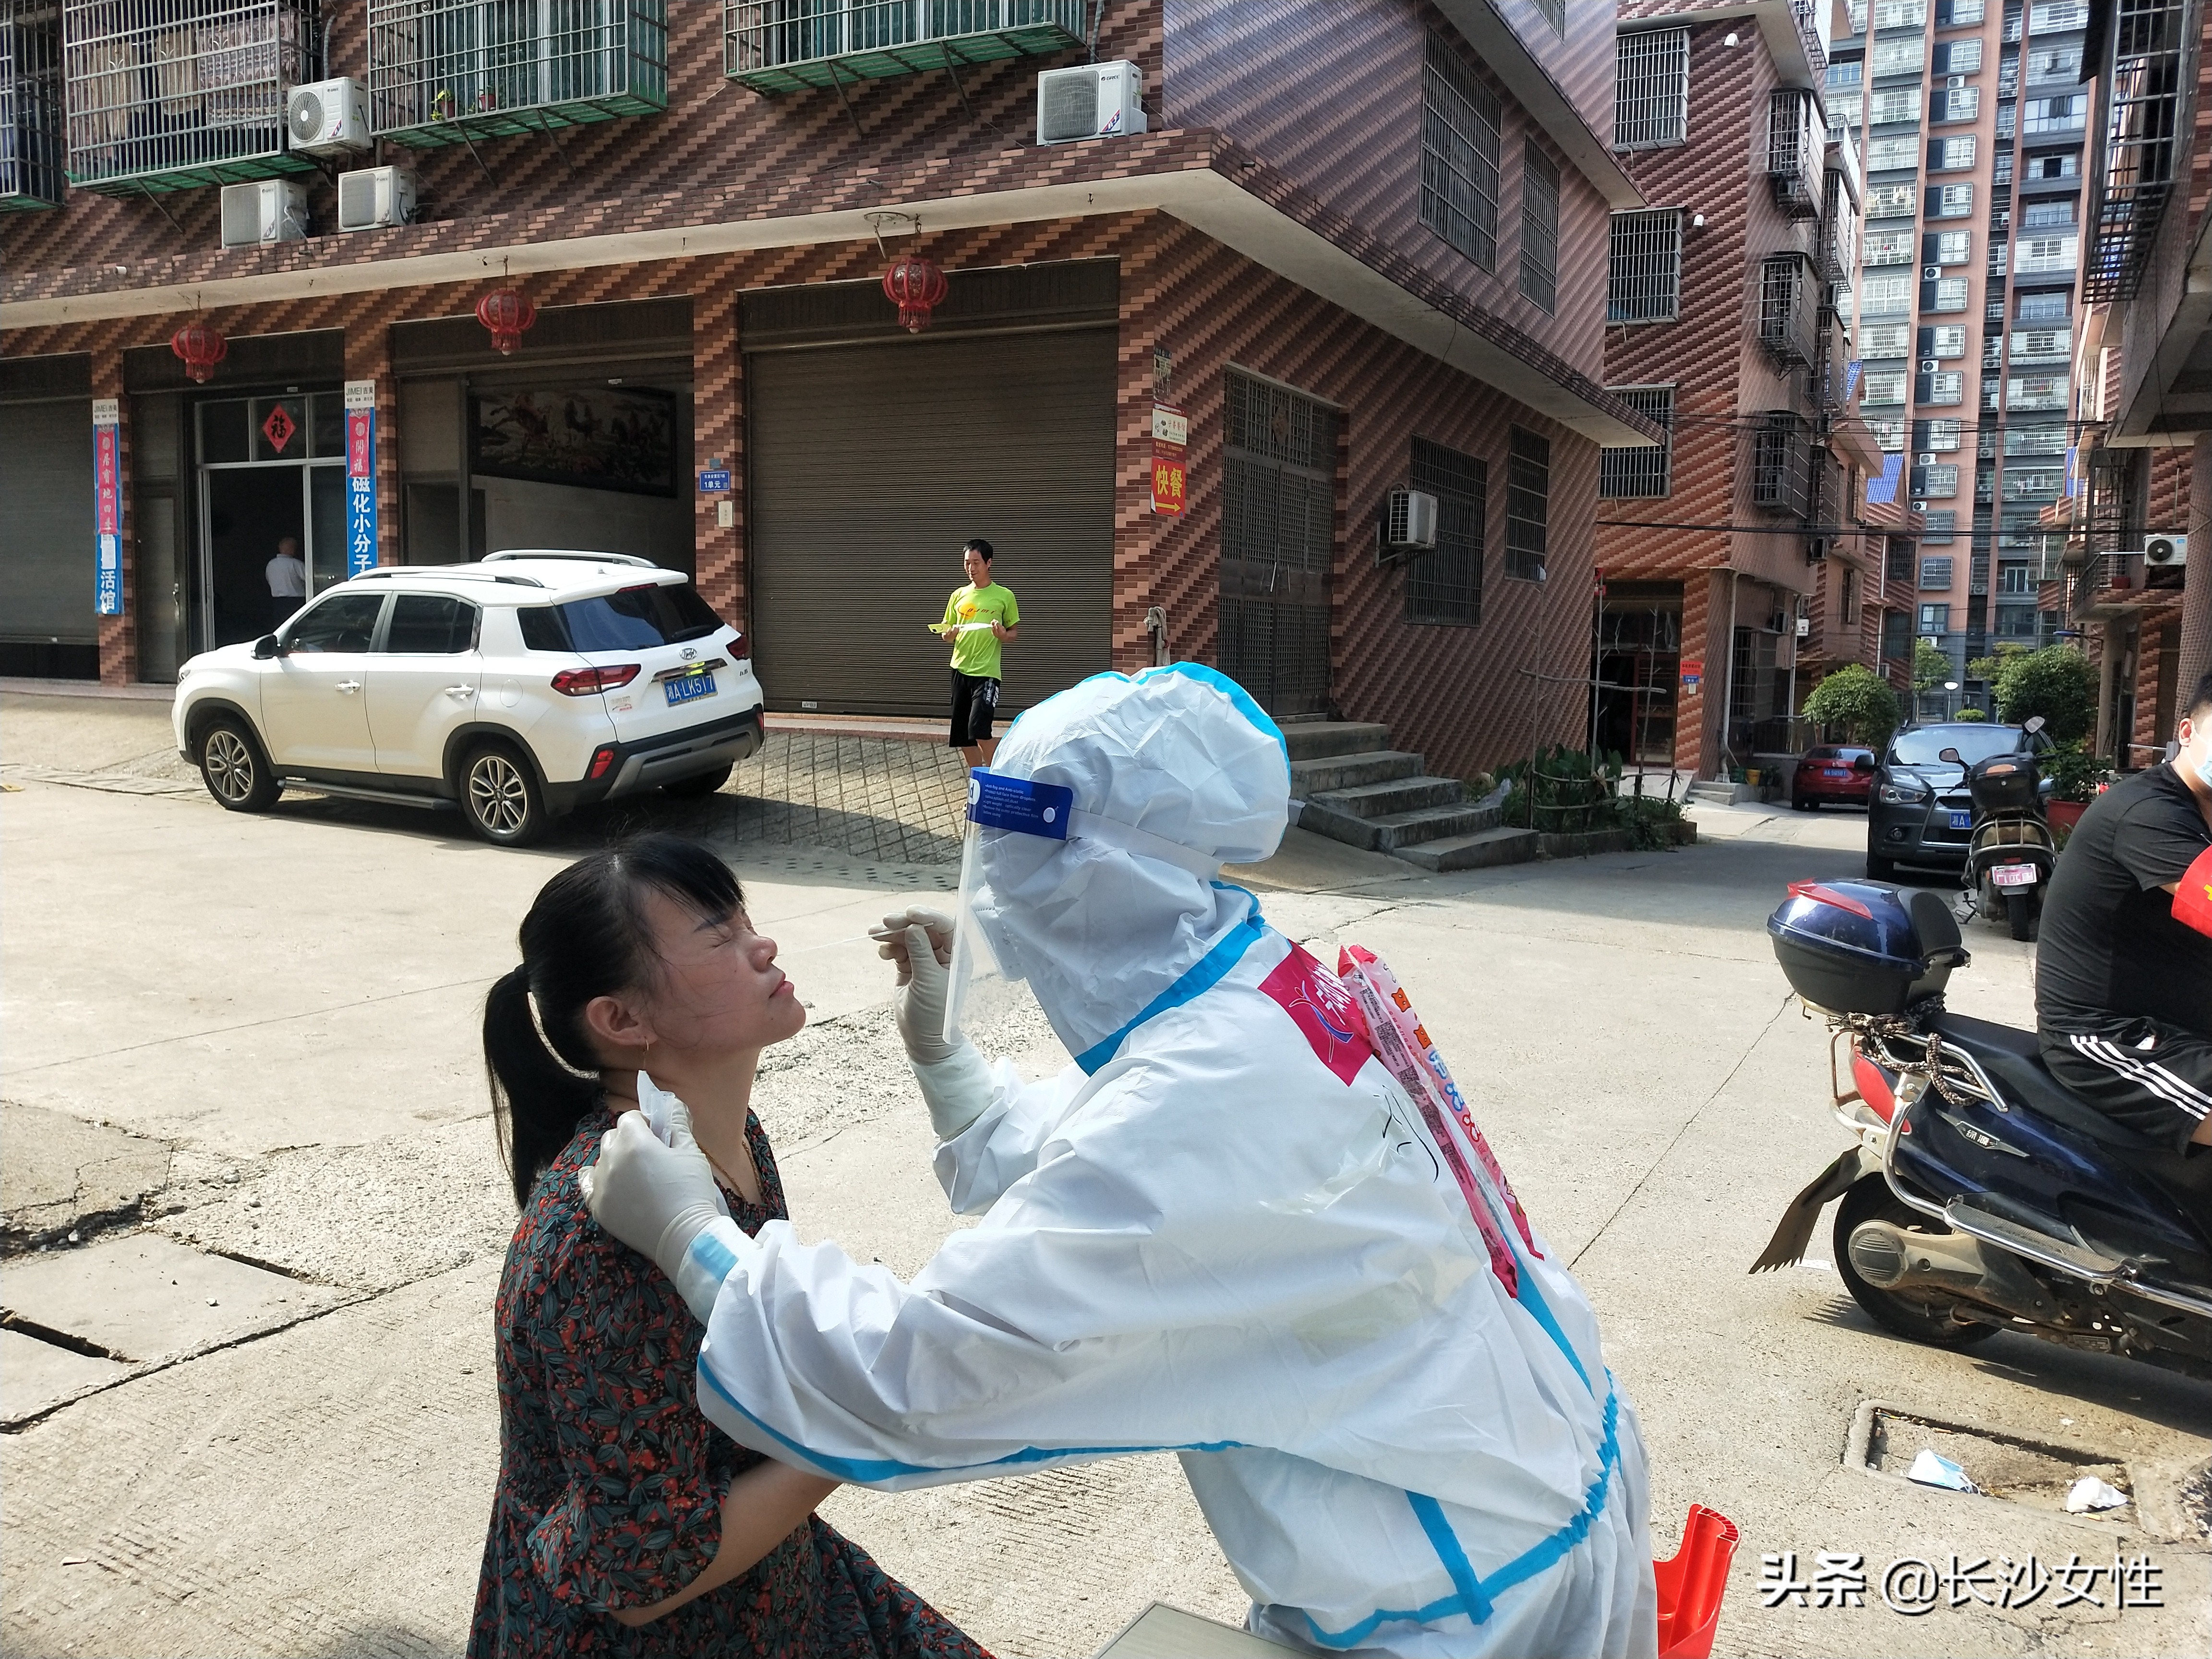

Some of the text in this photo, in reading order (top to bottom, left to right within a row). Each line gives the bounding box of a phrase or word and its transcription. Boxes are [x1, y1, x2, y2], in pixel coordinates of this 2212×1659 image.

[346, 386, 373, 396] JIMEI 吉美
[704, 481, 721, 489] 1单元
[1156, 465, 1182, 498] 快餐
[352, 477, 372, 572] 磁化小分子
